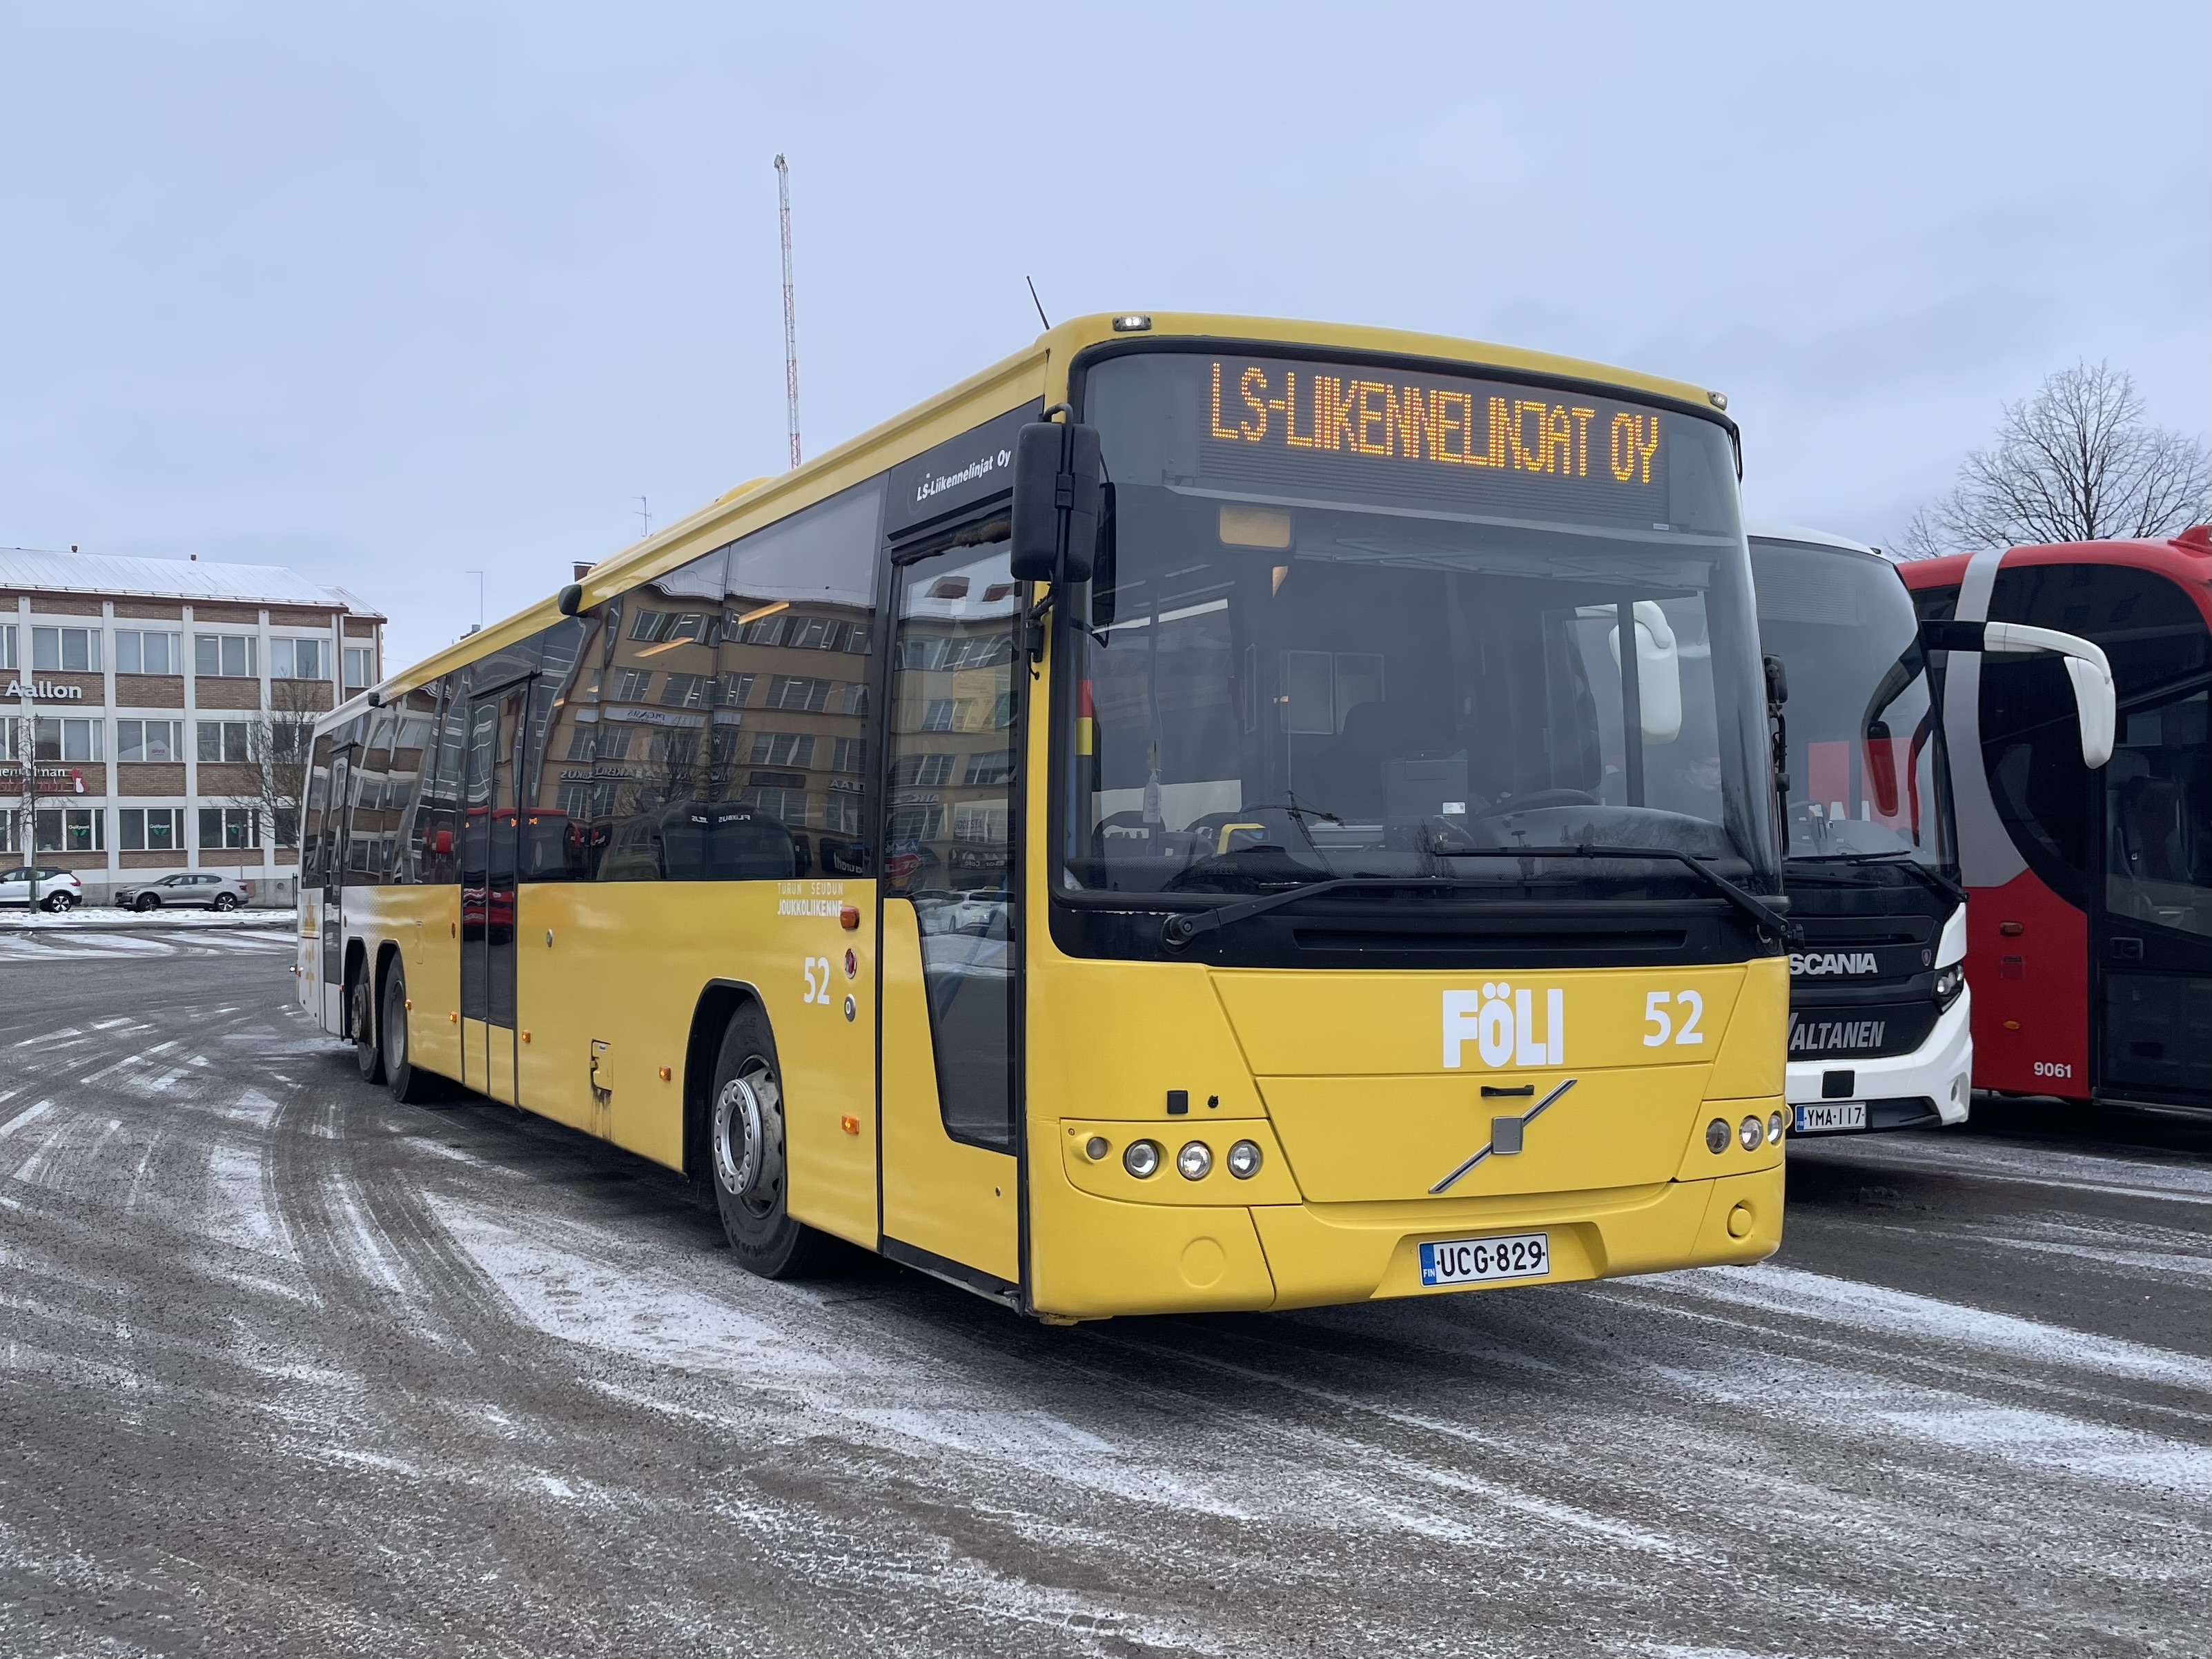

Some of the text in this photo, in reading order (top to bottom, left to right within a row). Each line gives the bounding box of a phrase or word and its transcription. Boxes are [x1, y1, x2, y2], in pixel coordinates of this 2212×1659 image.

[1211, 361, 1659, 484] LS-LIIKENNELINJAT OY
[917, 449, 1012, 502] LS-Liikennelinjat Oy
[5, 680, 82, 698] Aallon
[778, 883, 843, 895] TURUN SEUDUN
[777, 899, 843, 917] JOUKKOLIIKENNE
[1788, 953, 1879, 975] SCANIA
[803, 956, 830, 1005] 52
[1442, 982, 1563, 1068] FÖLI
[1643, 990, 1703, 1046] 52
[2034, 1061, 2071, 1078] 9061
[1808, 1107, 1862, 1127] YMA-117
[1440, 1241, 1542, 1277] UCG-829
[1423, 1268, 1436, 1278] FIN
